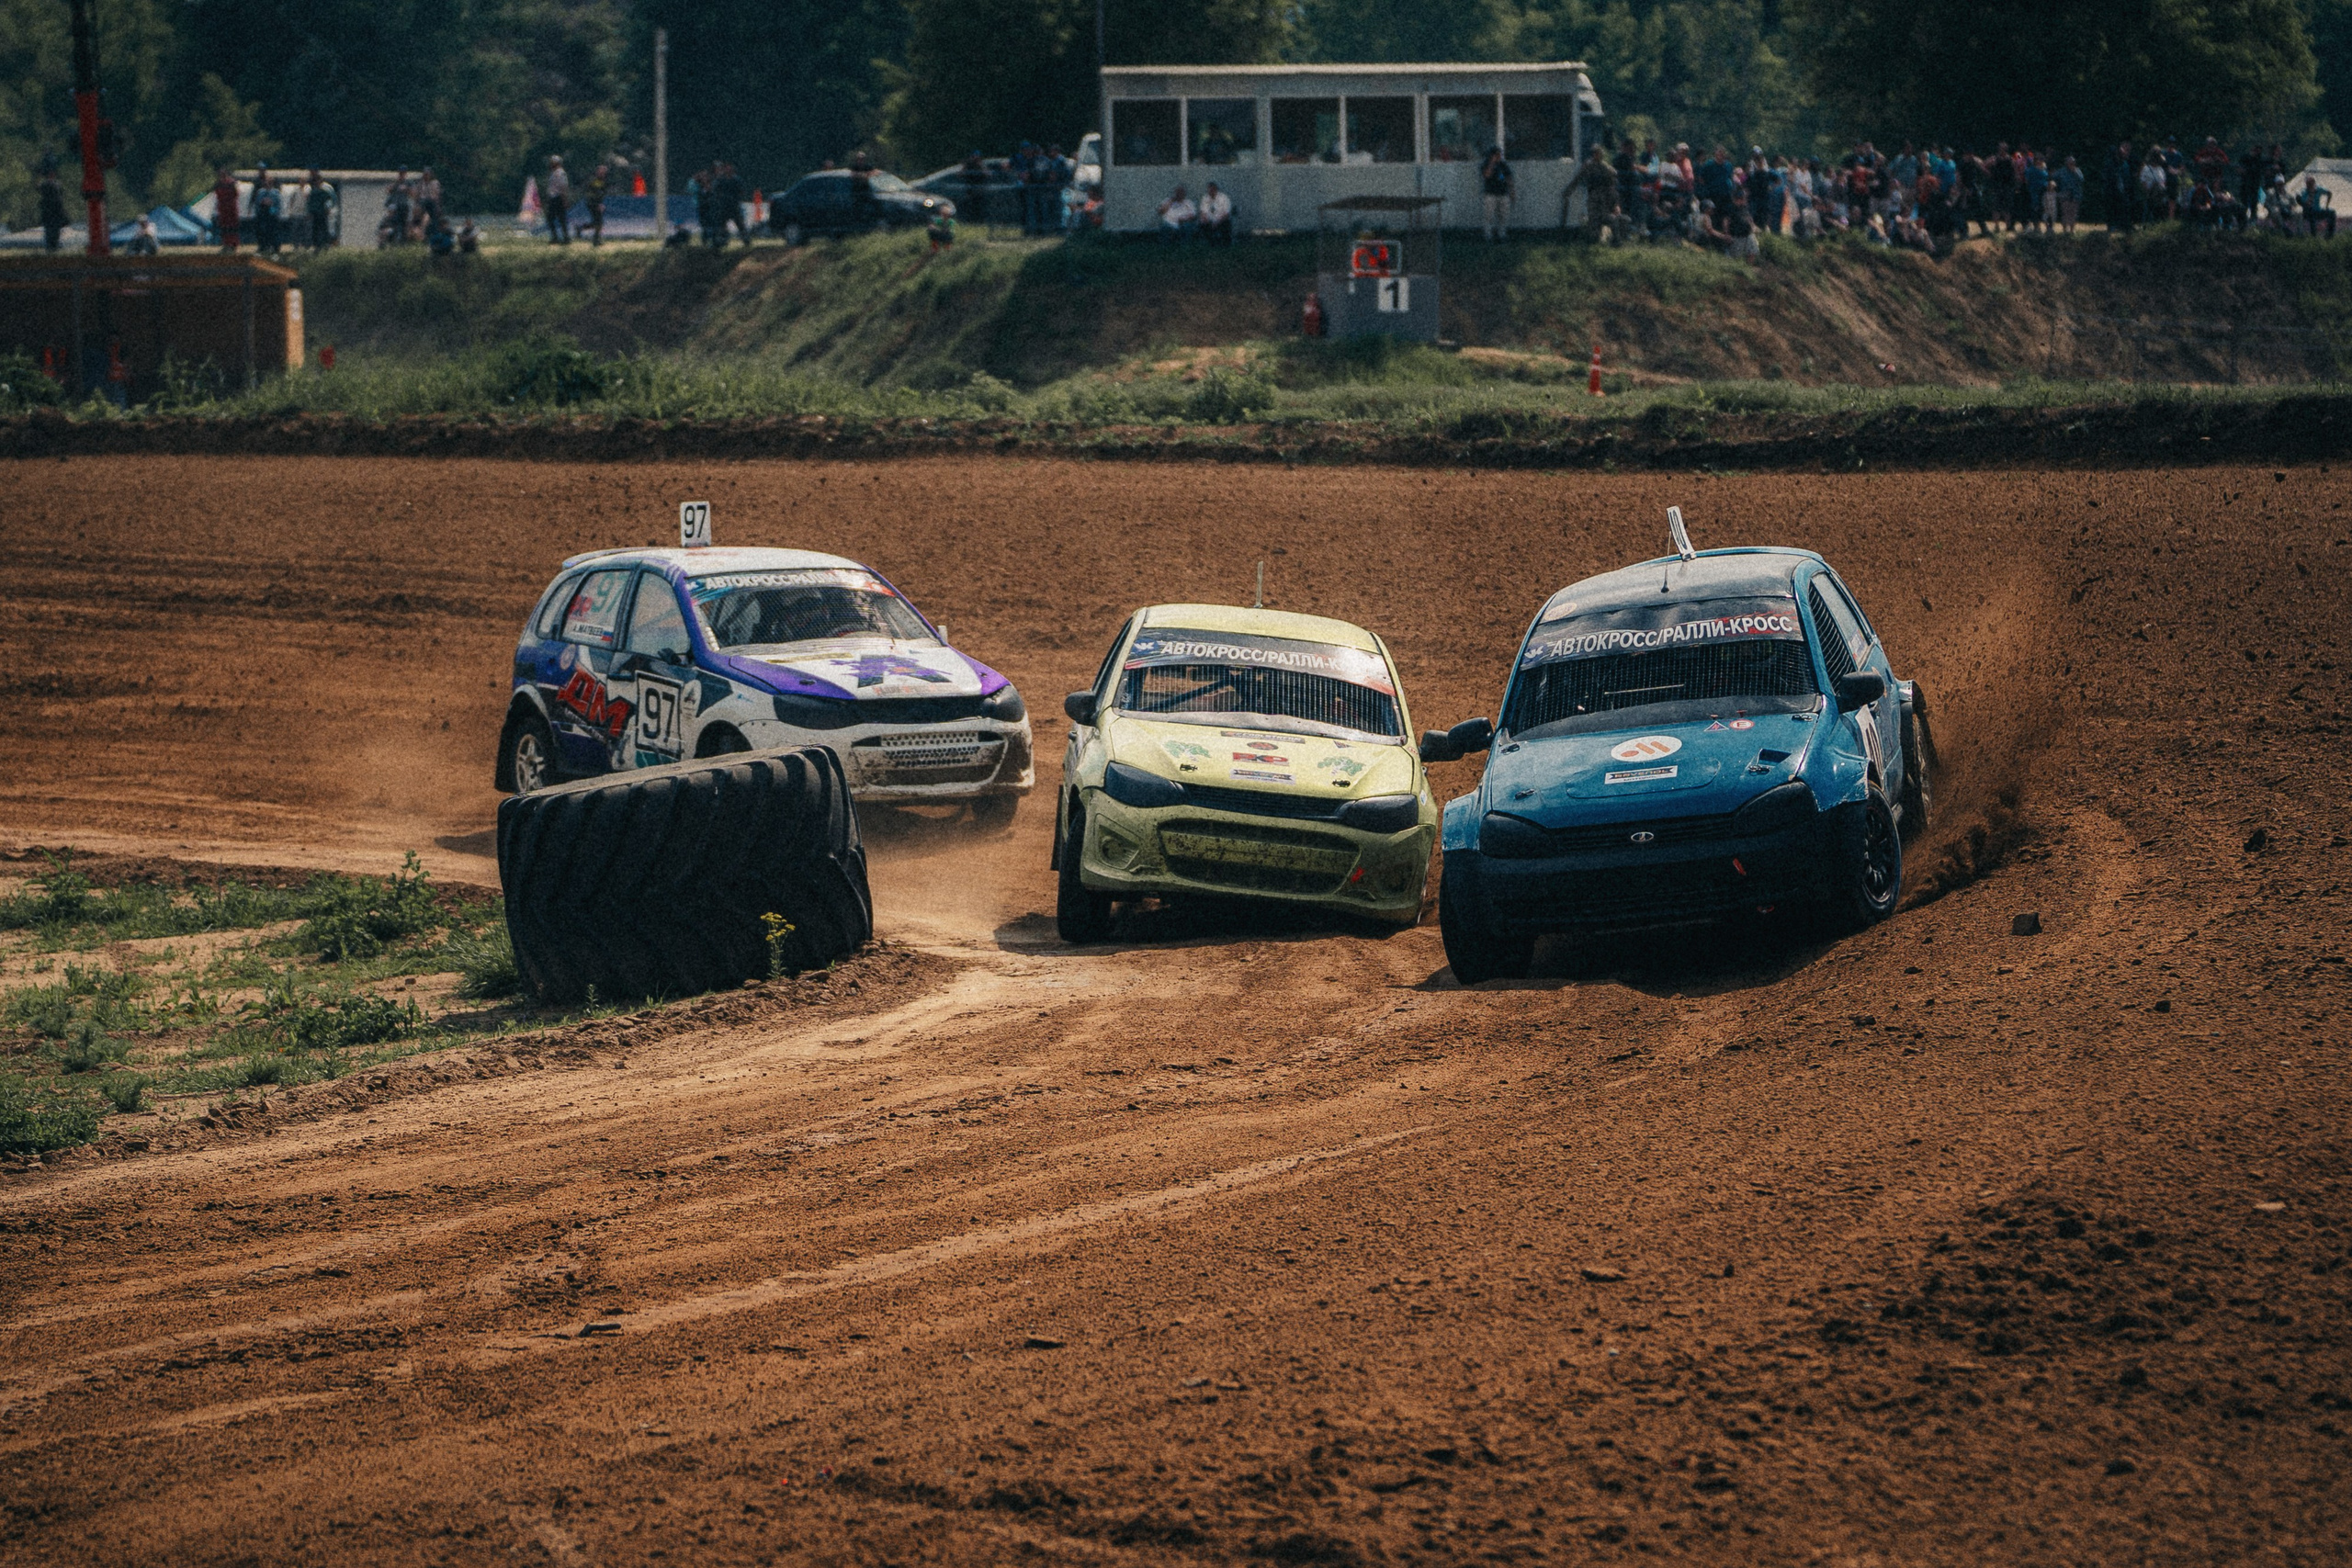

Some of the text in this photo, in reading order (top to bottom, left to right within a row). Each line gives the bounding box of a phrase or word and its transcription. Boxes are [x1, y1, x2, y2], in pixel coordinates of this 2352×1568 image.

[1385, 279, 1399, 309] 1
[684, 504, 707, 538] 97
[591, 570, 628, 614] 97
[1550, 615, 1792, 658] АВТОКРОСС/РАЛЛИ-КРОСС
[643, 687, 676, 743] 97
